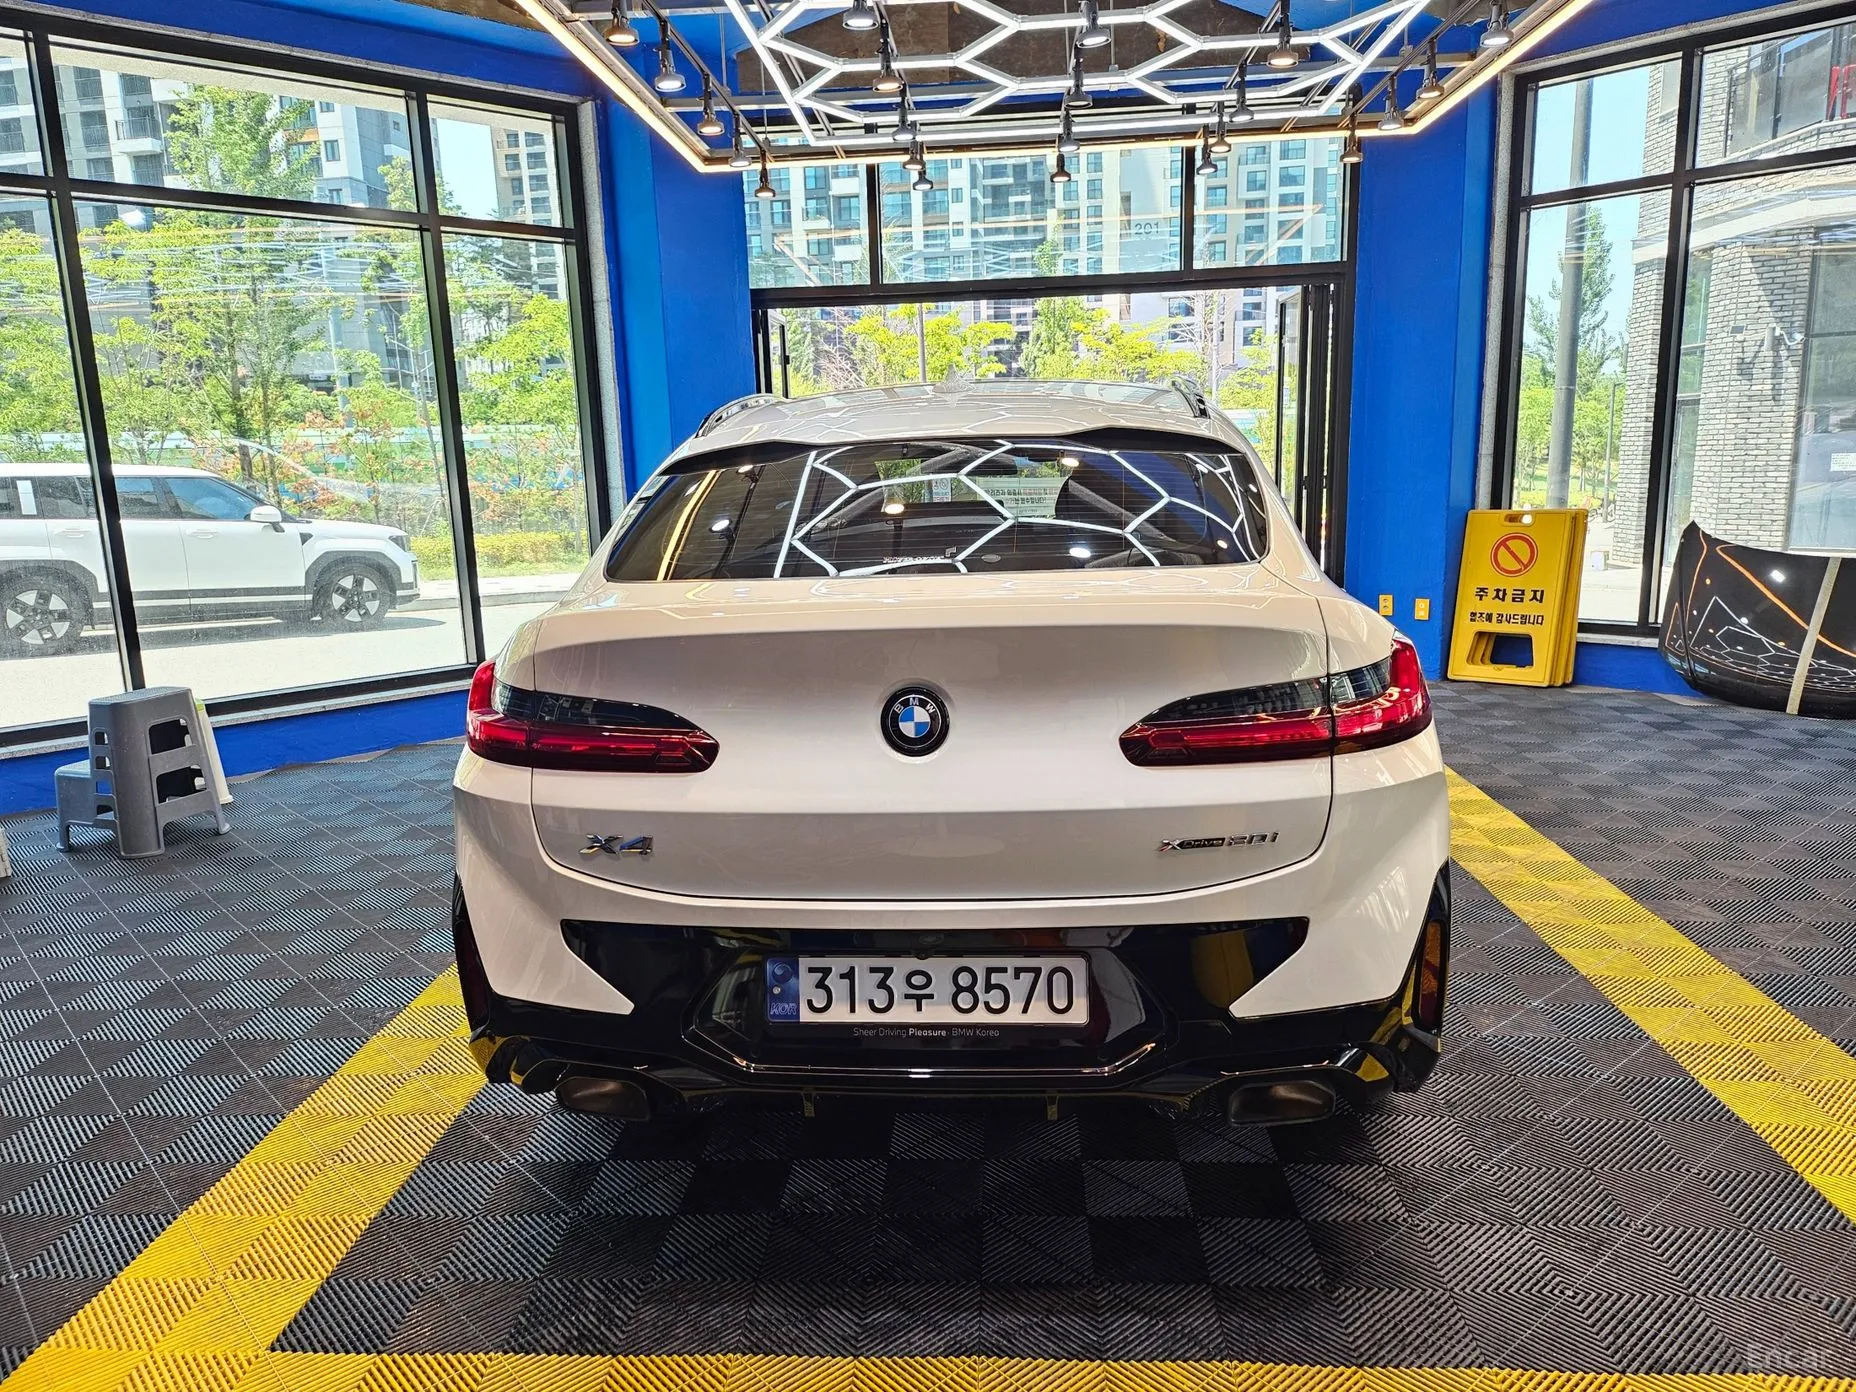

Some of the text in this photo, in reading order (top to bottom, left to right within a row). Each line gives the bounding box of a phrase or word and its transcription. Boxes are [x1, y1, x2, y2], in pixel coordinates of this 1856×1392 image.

[1134, 222, 1160, 235] 201
[1475, 587, 1545, 603] 주차금지
[1496, 613, 1544, 625] 감사드립니다
[894, 697, 936, 714] BMW
[579, 834, 653, 855] X4
[806, 966, 1074, 1015] 313우 8570
[770, 1003, 797, 1015] KOR
[853, 1027, 1000, 1038] Sheer Driving Pleasure BMW Korea
